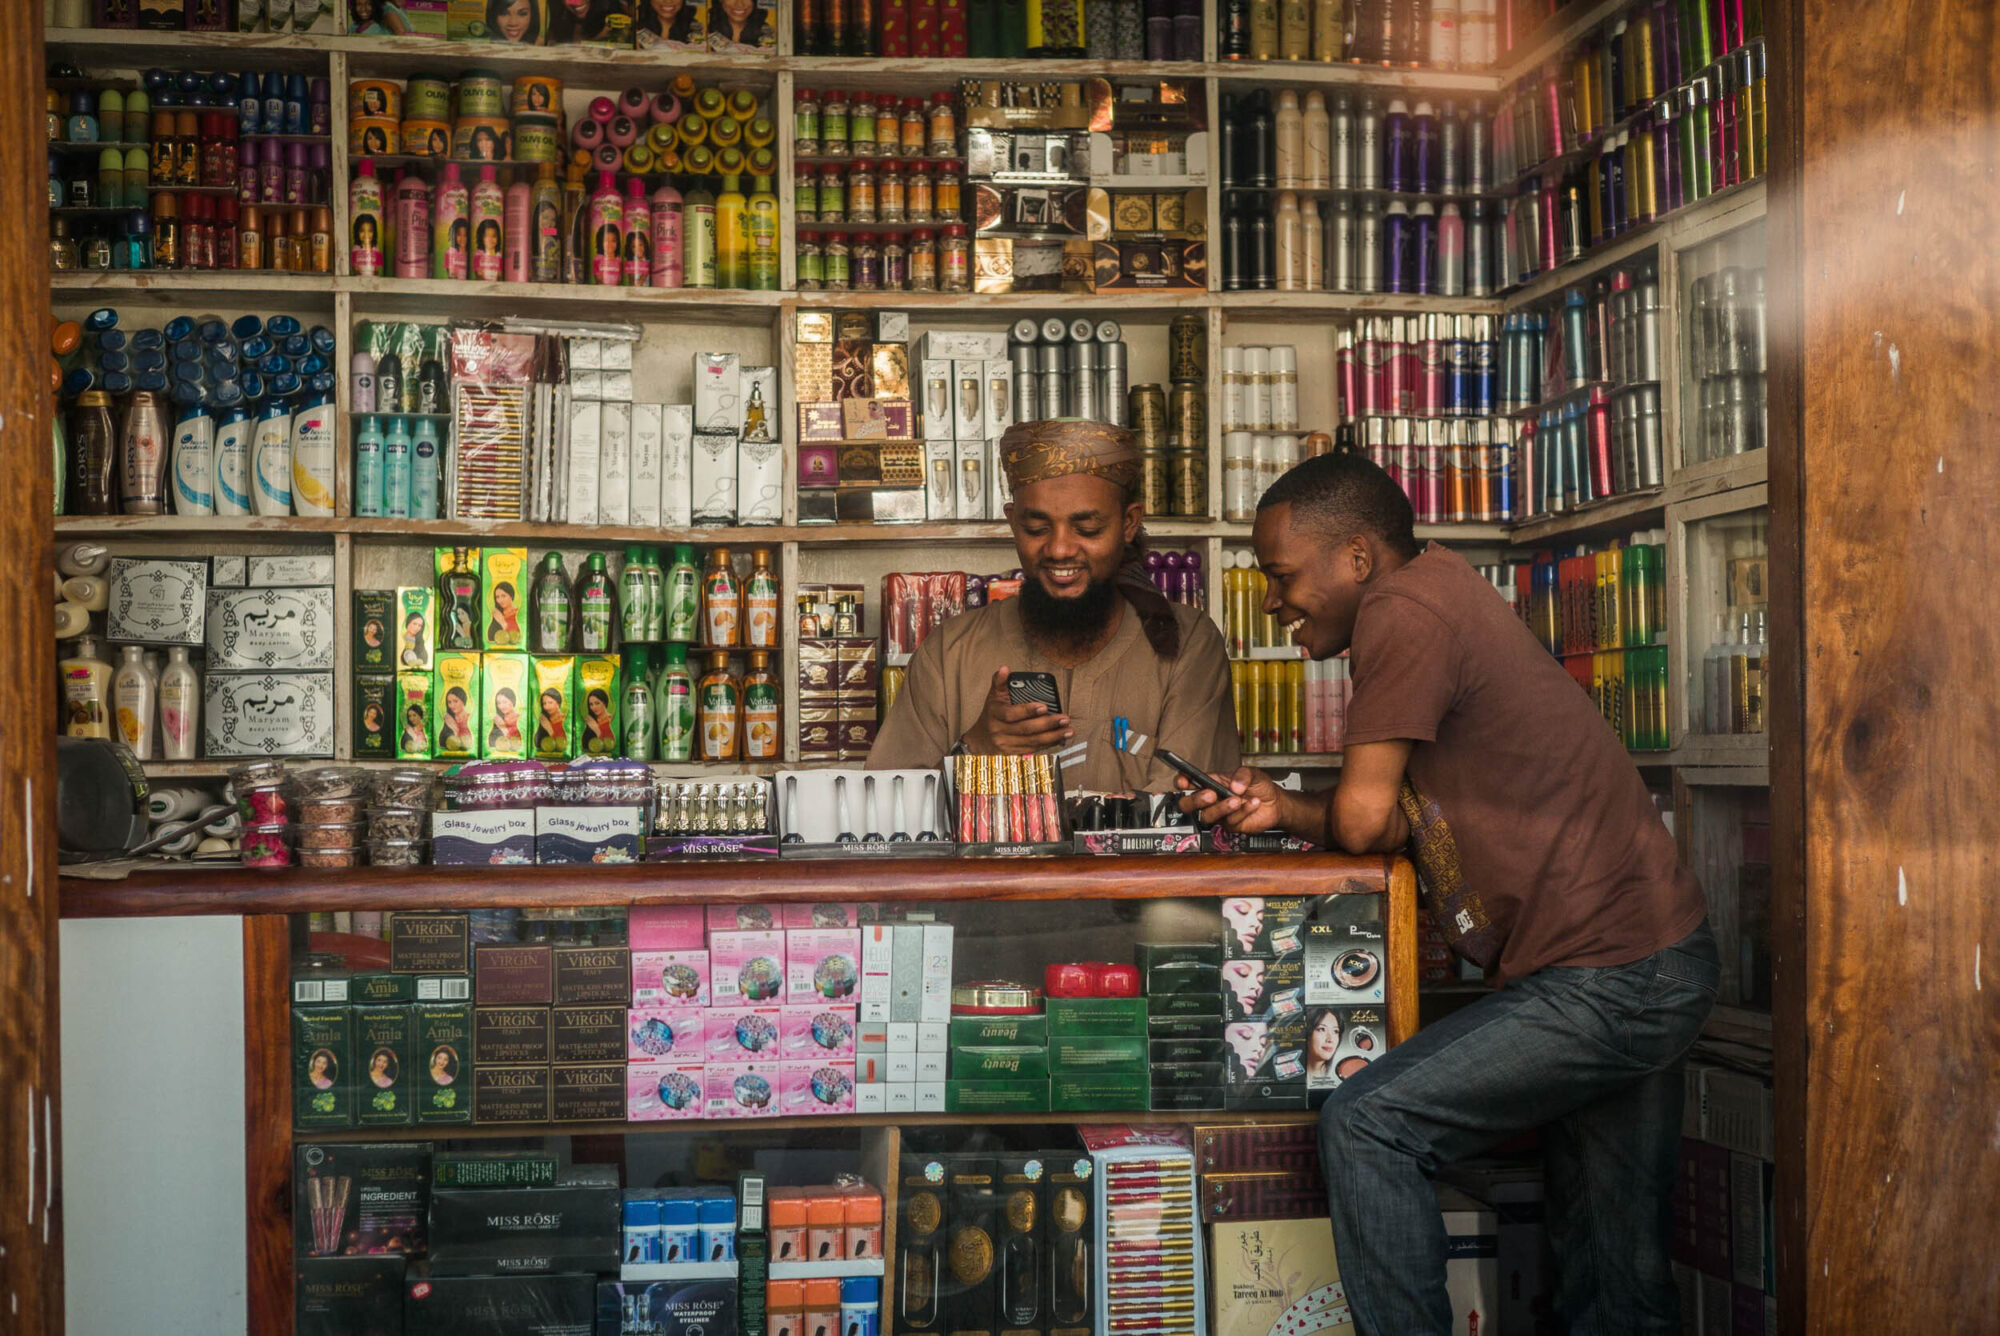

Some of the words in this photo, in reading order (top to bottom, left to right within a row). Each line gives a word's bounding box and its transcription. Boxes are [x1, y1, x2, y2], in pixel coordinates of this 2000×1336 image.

[77, 434, 87, 487] LORYS
[128, 434, 136, 487] LORYS
[243, 608, 296, 633] مريم
[249, 630, 290, 638] Maryam
[243, 694, 295, 719] مريم
[708, 697, 732, 706] Vatika
[750, 697, 774, 706] Vatika
[248, 715, 290, 724] Maryam
[444, 820, 471, 829] Glass
[472, 823, 507, 834] jewelry
[508, 820, 526, 828] box
[548, 818, 575, 827] Glass
[576, 821, 610, 833] jewelry
[612, 819, 630, 827] box
[682, 844, 708, 854] MISS
[994, 846, 1011, 854] MISS
[406, 924, 454, 936] VIRGIN
[1311, 925, 1333, 934] XXL
[491, 955, 538, 967] VIRGIN
[569, 956, 617, 968] VIRGIN
[1349, 959, 1364, 969] XXL
[364, 982, 399, 994] Amla
[488, 1015, 537, 1026] VIRGIN
[566, 1015, 614, 1026] VIRGIN
[366, 1028, 402, 1041] Amla
[426, 1026, 463, 1039] Amla
[979, 1026, 1018, 1040] Beauty
[980, 1058, 1020, 1072] Beauty
[488, 1074, 537, 1086] VIRGIN
[565, 1073, 613, 1085] VIRGIN
[360, 1191, 418, 1201] INGREDIENT
[487, 1215, 521, 1226] MISS
[497, 1258, 521, 1267] MISS
[305, 1284, 333, 1293] MISS
[665, 1302, 690, 1311] MISS
